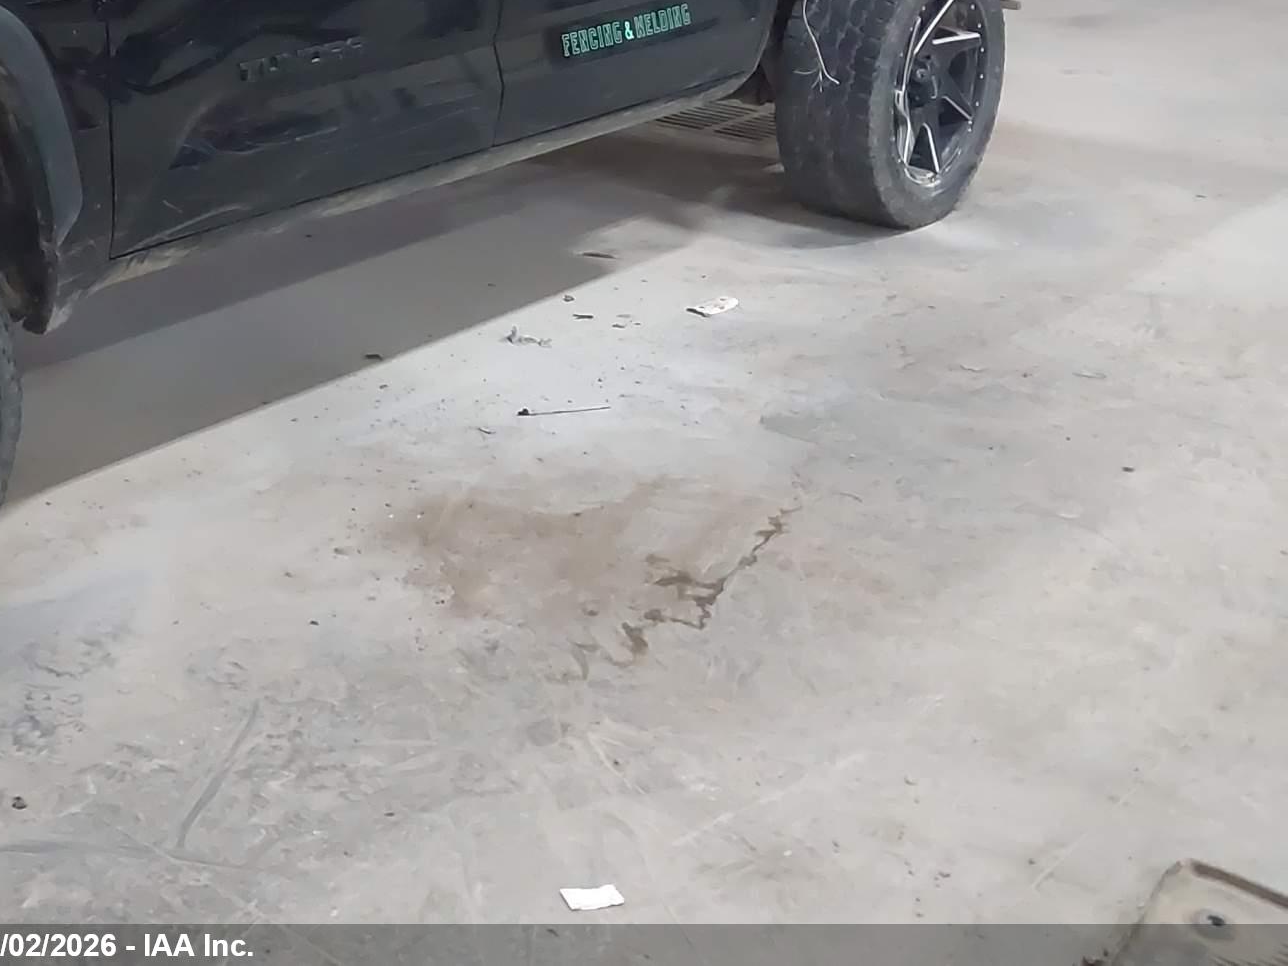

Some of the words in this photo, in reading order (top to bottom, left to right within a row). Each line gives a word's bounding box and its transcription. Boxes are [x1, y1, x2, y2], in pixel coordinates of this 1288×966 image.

[562, 21, 622, 56] FENCING
[624, 21, 634, 40] &
[633, 3, 691, 39] WELDING
